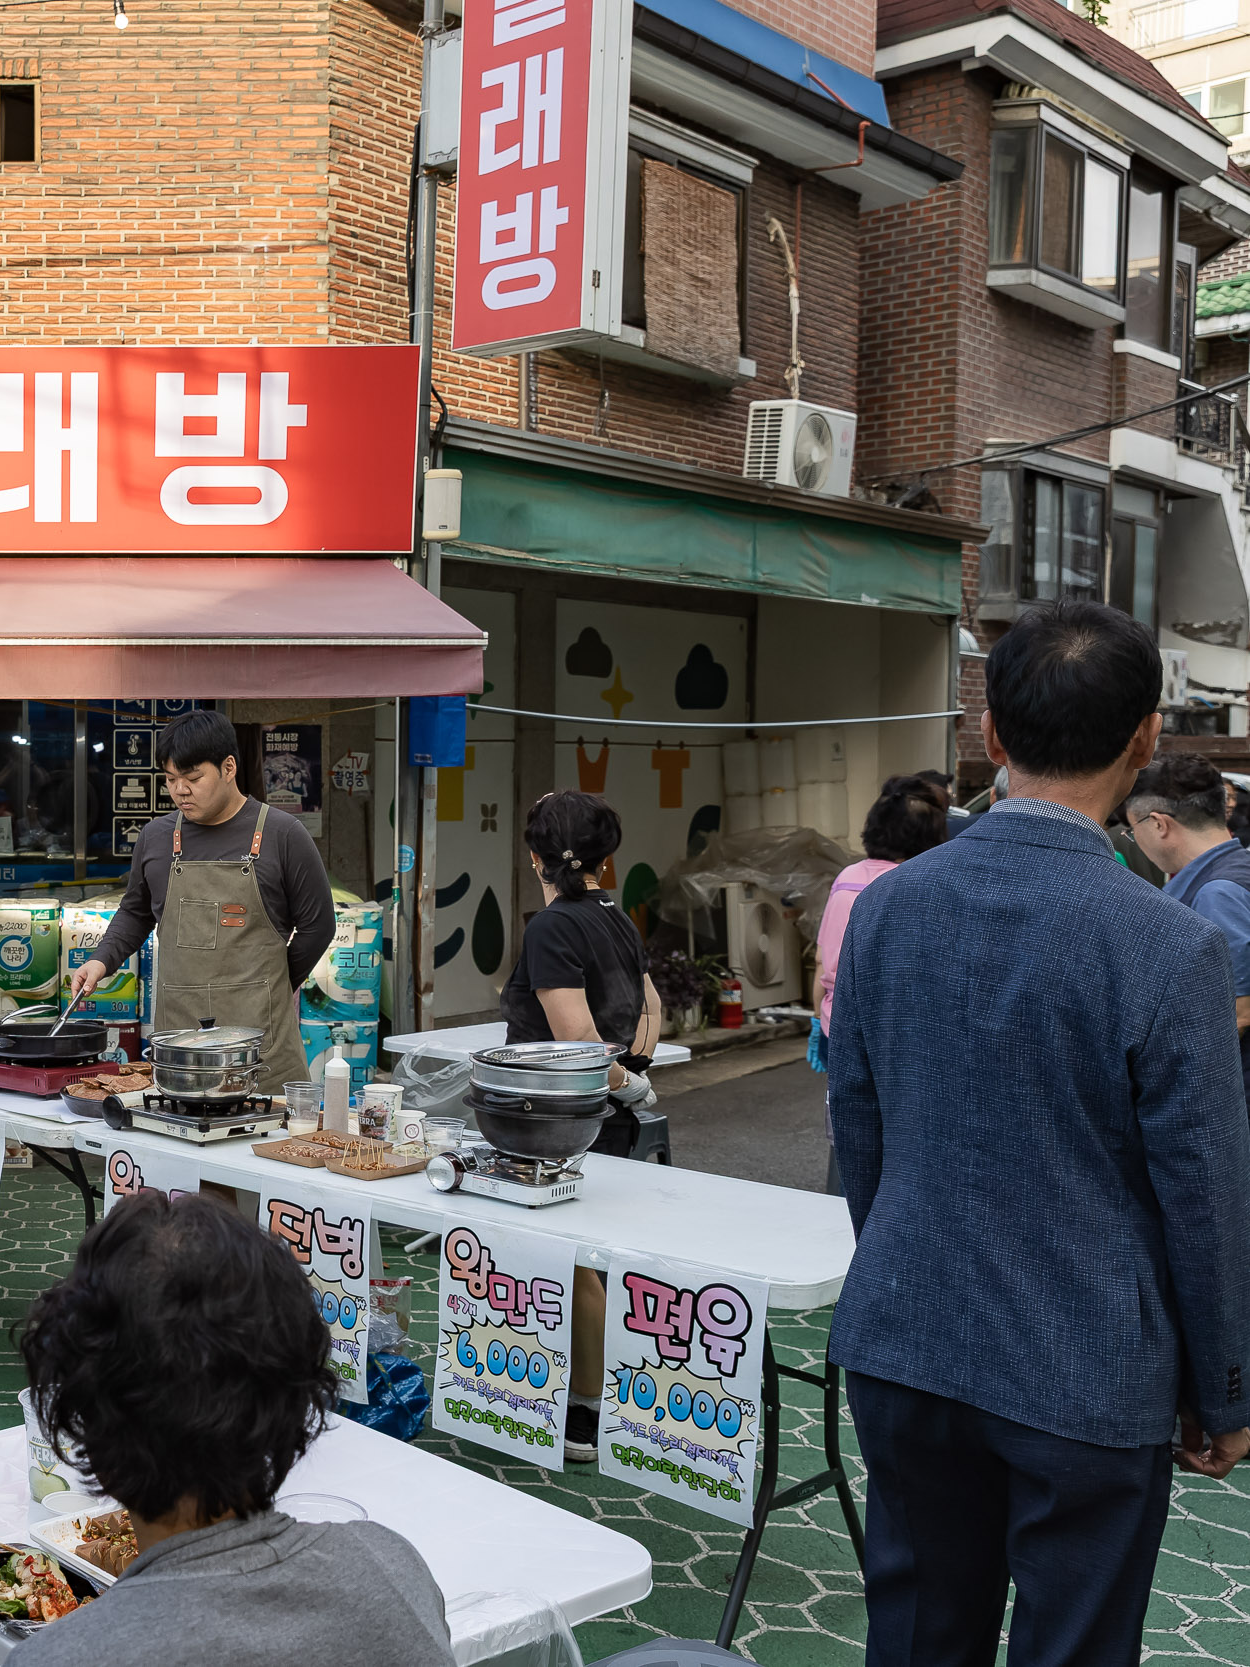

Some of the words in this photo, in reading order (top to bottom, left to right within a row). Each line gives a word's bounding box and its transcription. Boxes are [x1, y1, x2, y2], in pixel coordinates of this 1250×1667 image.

[265, 732, 299, 742] 전통시장
[265, 743, 299, 752] 화재예방
[334, 770, 364, 787] 촬영중
[3, 946, 25, 955] 깨끗한
[338, 952, 375, 968] 코디
[445, 1226, 565, 1331] 왕만두
[447, 1293, 478, 1317] 4개
[623, 1271, 752, 1378] 편육
